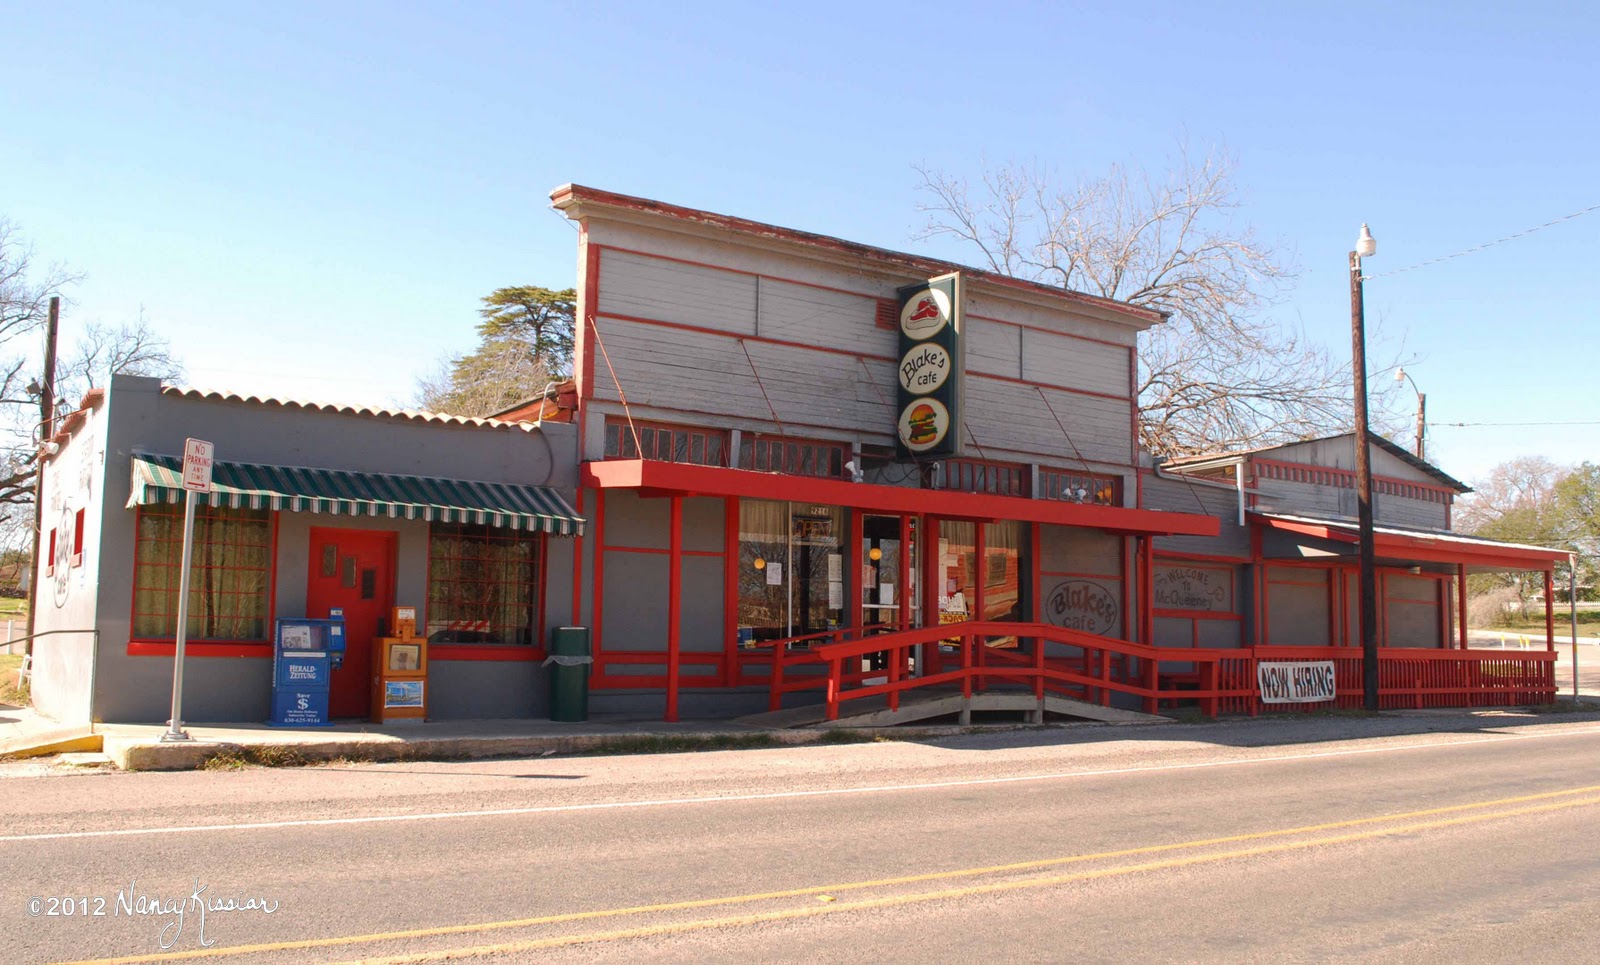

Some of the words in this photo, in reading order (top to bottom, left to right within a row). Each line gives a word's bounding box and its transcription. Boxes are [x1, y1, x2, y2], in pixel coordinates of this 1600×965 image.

[902, 349, 945, 388] Blake's
[917, 371, 937, 385] cafe
[195, 444, 206, 455] NO
[187, 454, 210, 468] PARKING
[191, 473, 204, 481] TIME
[811, 507, 828, 515] 9216
[795, 519, 831, 538] OPEN
[1168, 568, 1209, 585] WELCOME
[1182, 581, 1191, 591] TO
[1051, 584, 1115, 624] Blake's
[1155, 590, 1213, 610] McQueeney
[1063, 615, 1096, 631] cafe
[289, 665, 317, 673] HERALD-
[1261, 667, 1290, 698] NOW
[1293, 666, 1333, 698] HIRING
